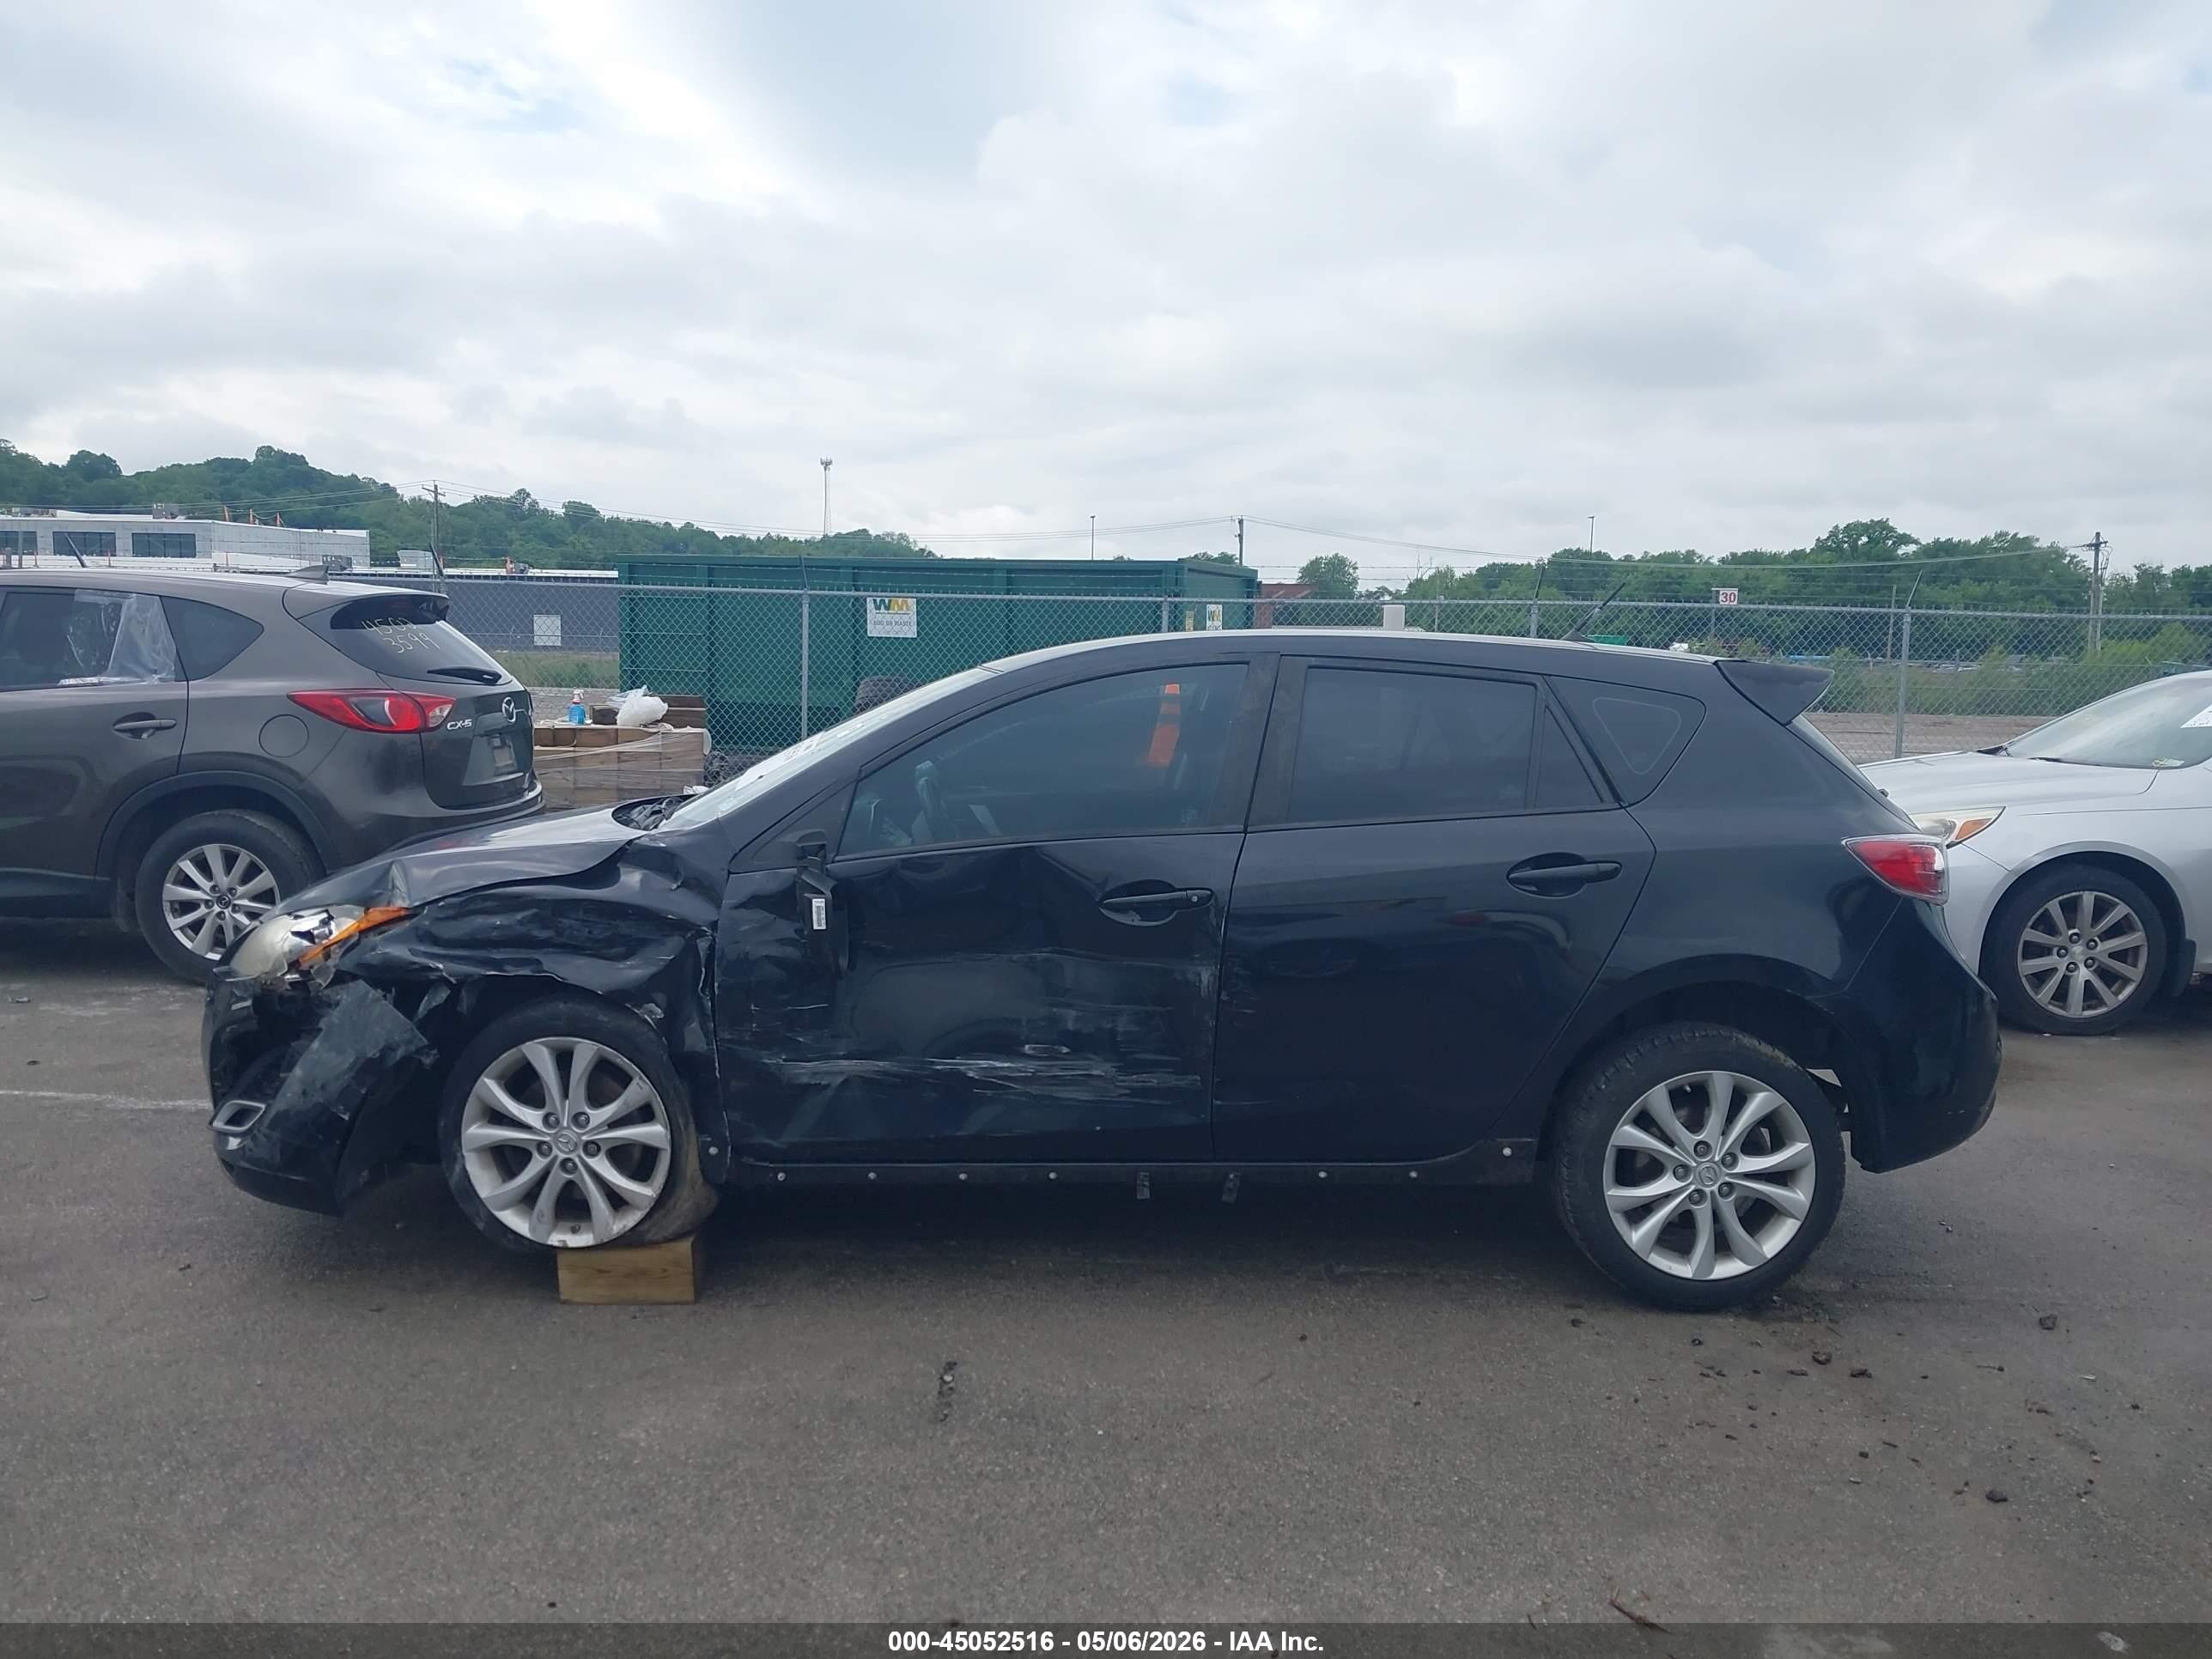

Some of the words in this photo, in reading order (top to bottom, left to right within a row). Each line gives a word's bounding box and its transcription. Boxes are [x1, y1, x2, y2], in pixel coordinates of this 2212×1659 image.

[1721, 592, 1736, 603] 30
[872, 599, 908, 611] WM
[382, 632, 441, 653] 3599
[447, 719, 473, 731] CX-5
